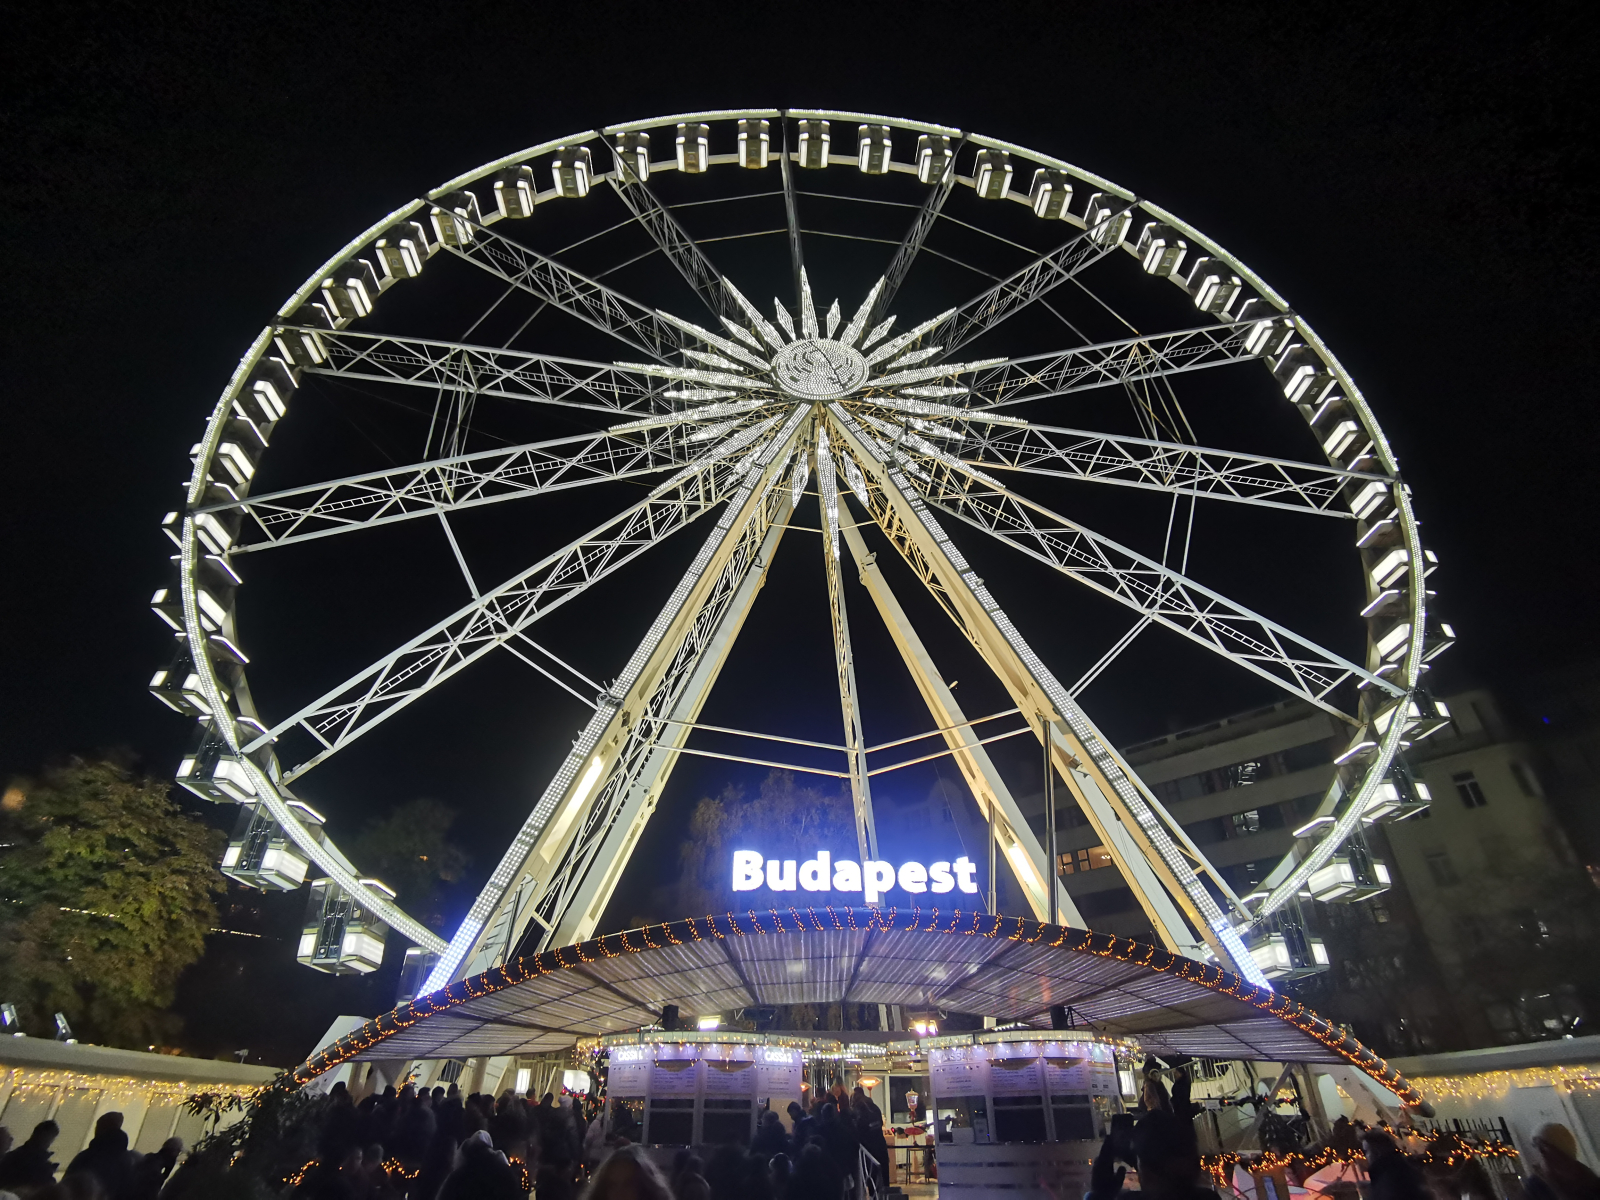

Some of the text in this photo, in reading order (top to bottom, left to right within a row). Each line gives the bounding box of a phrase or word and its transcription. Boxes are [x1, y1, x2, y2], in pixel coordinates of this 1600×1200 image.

[732, 850, 978, 903] Budapest
[765, 1051, 793, 1063] CASSA 2
